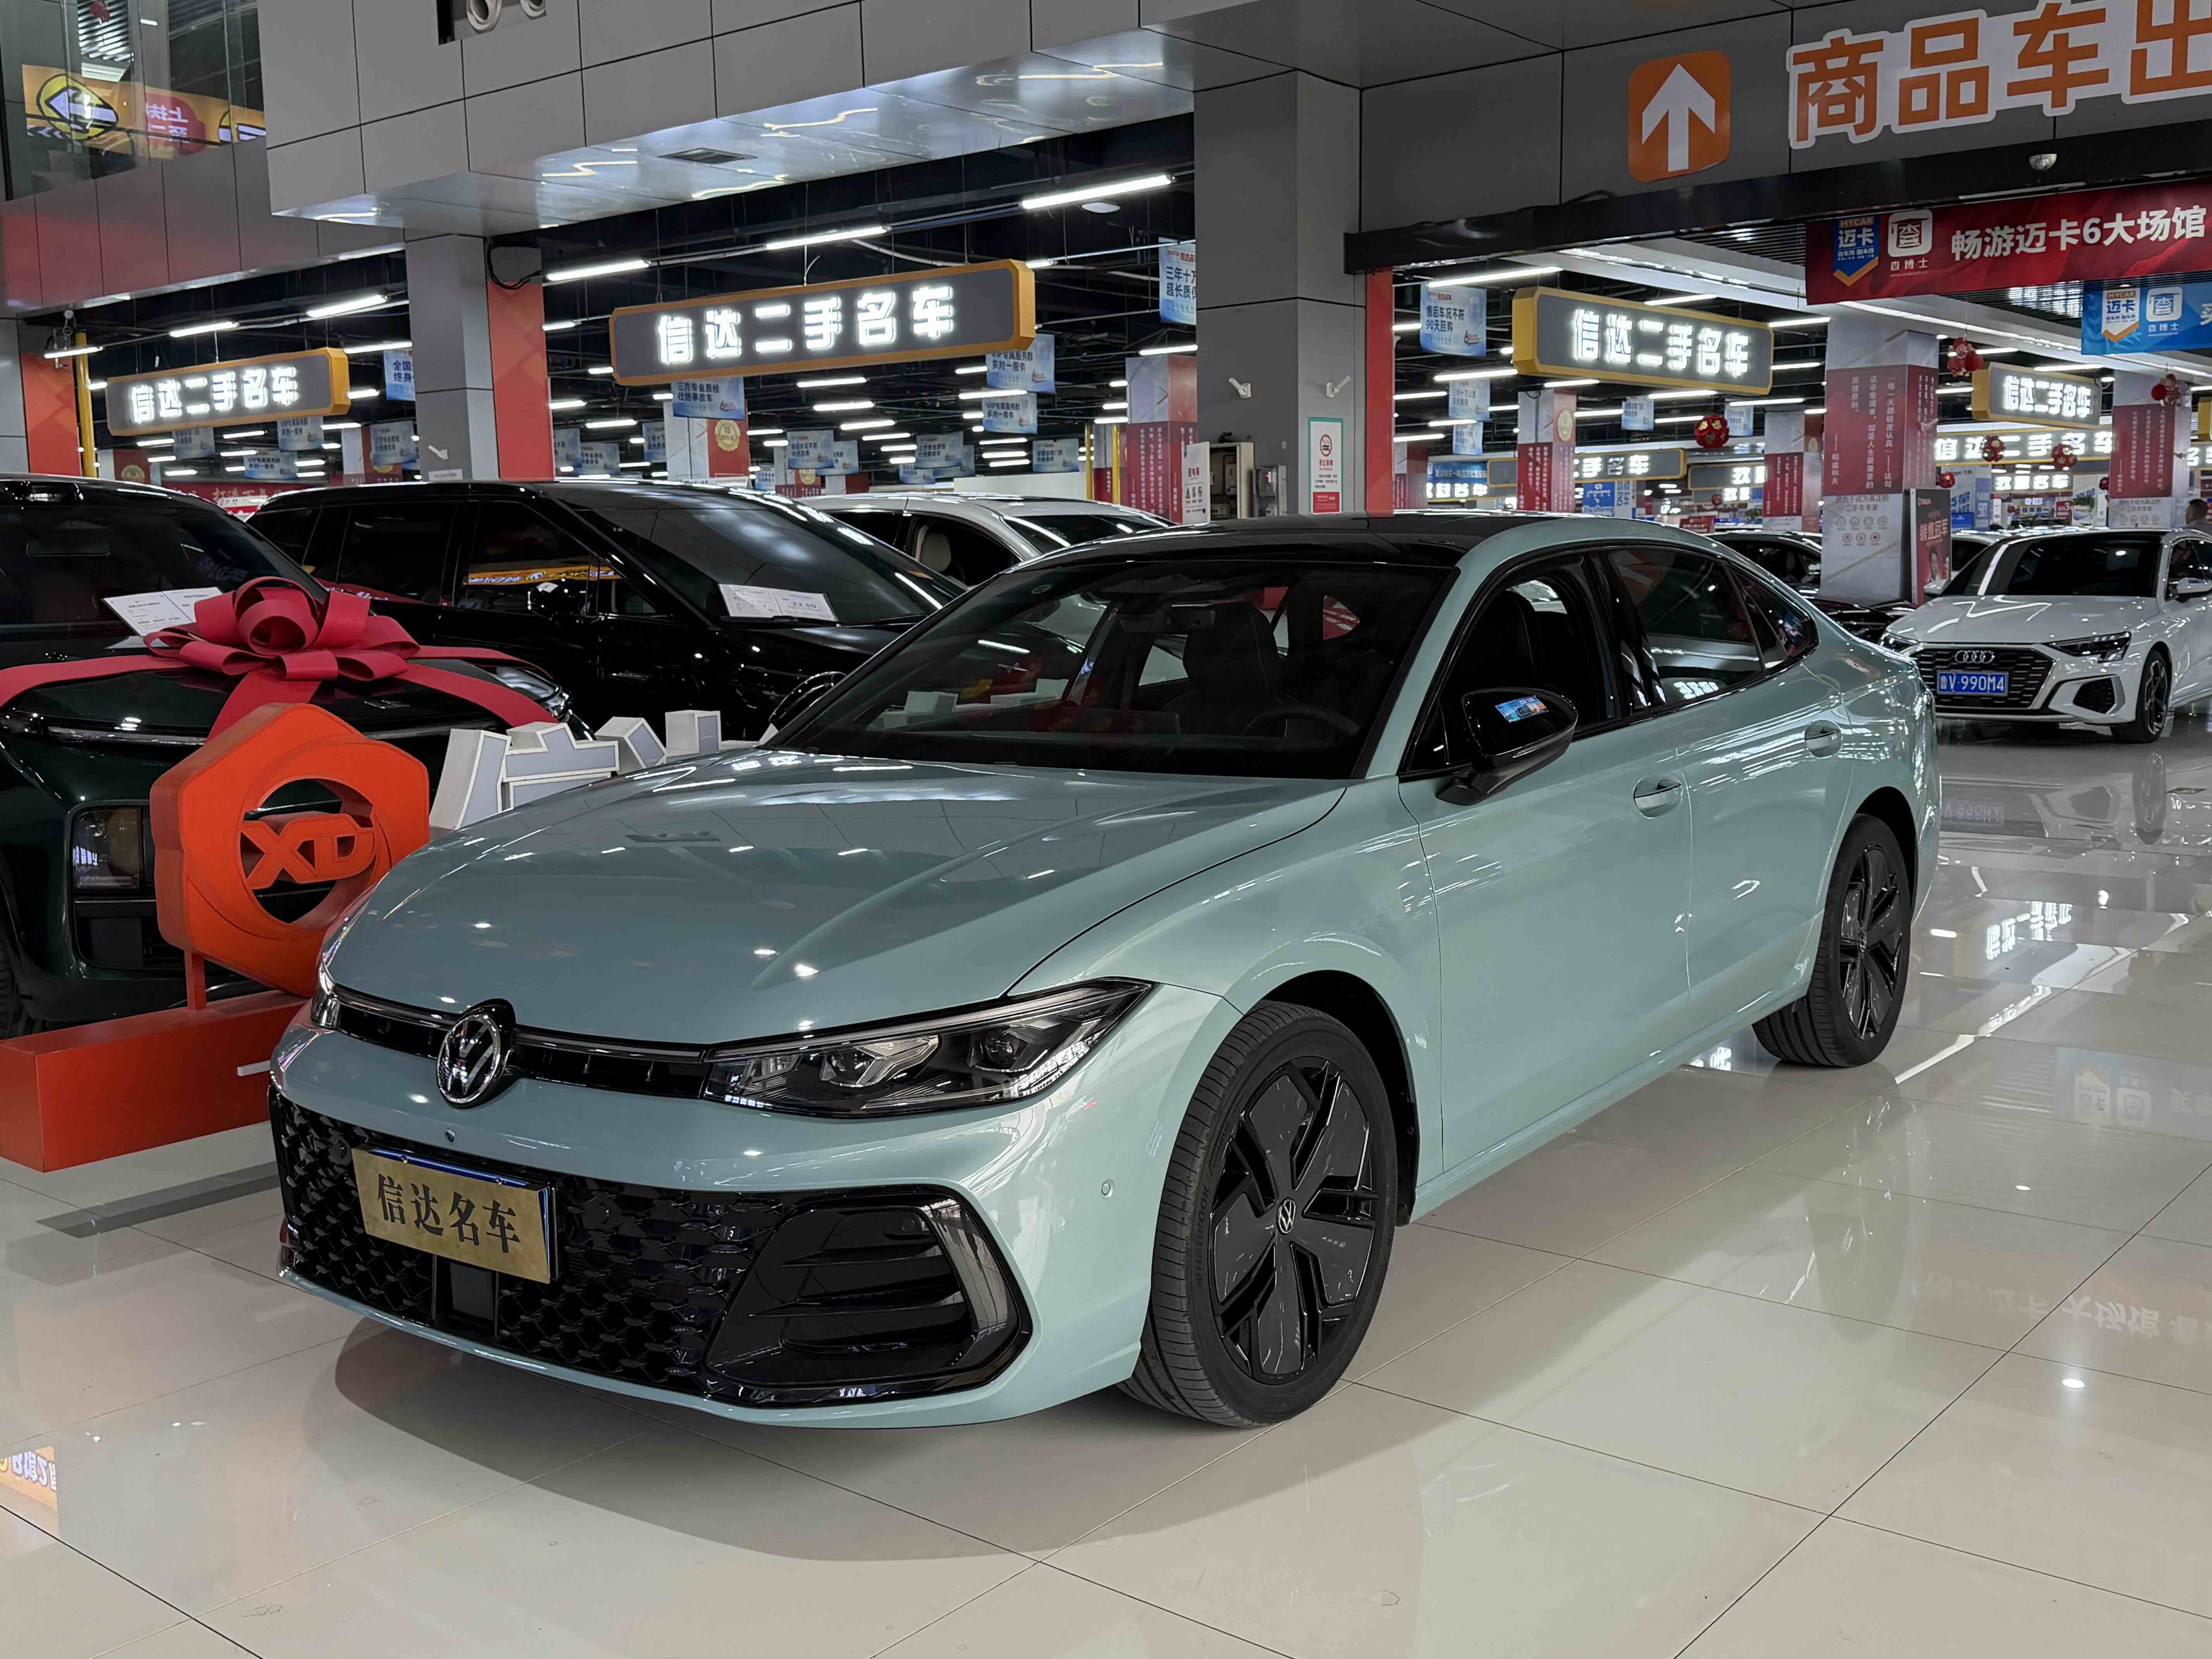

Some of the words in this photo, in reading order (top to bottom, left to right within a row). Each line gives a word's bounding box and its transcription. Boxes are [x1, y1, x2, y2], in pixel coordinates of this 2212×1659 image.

[1838, 227, 1874, 248] 迈卡
[1841, 217, 1874, 228] MYCAR
[1951, 205, 2206, 261] 畅游迈卡6大场馆
[659, 285, 953, 364] 信达二手名车
[2106, 299, 2136, 314] 迈卡
[1574, 309, 1749, 377] 信达二手名车
[131, 366, 299, 423] 信达二手名车
[2003, 375, 2091, 418] 信达二手名车
[378, 1173, 520, 1253] 信达名车
